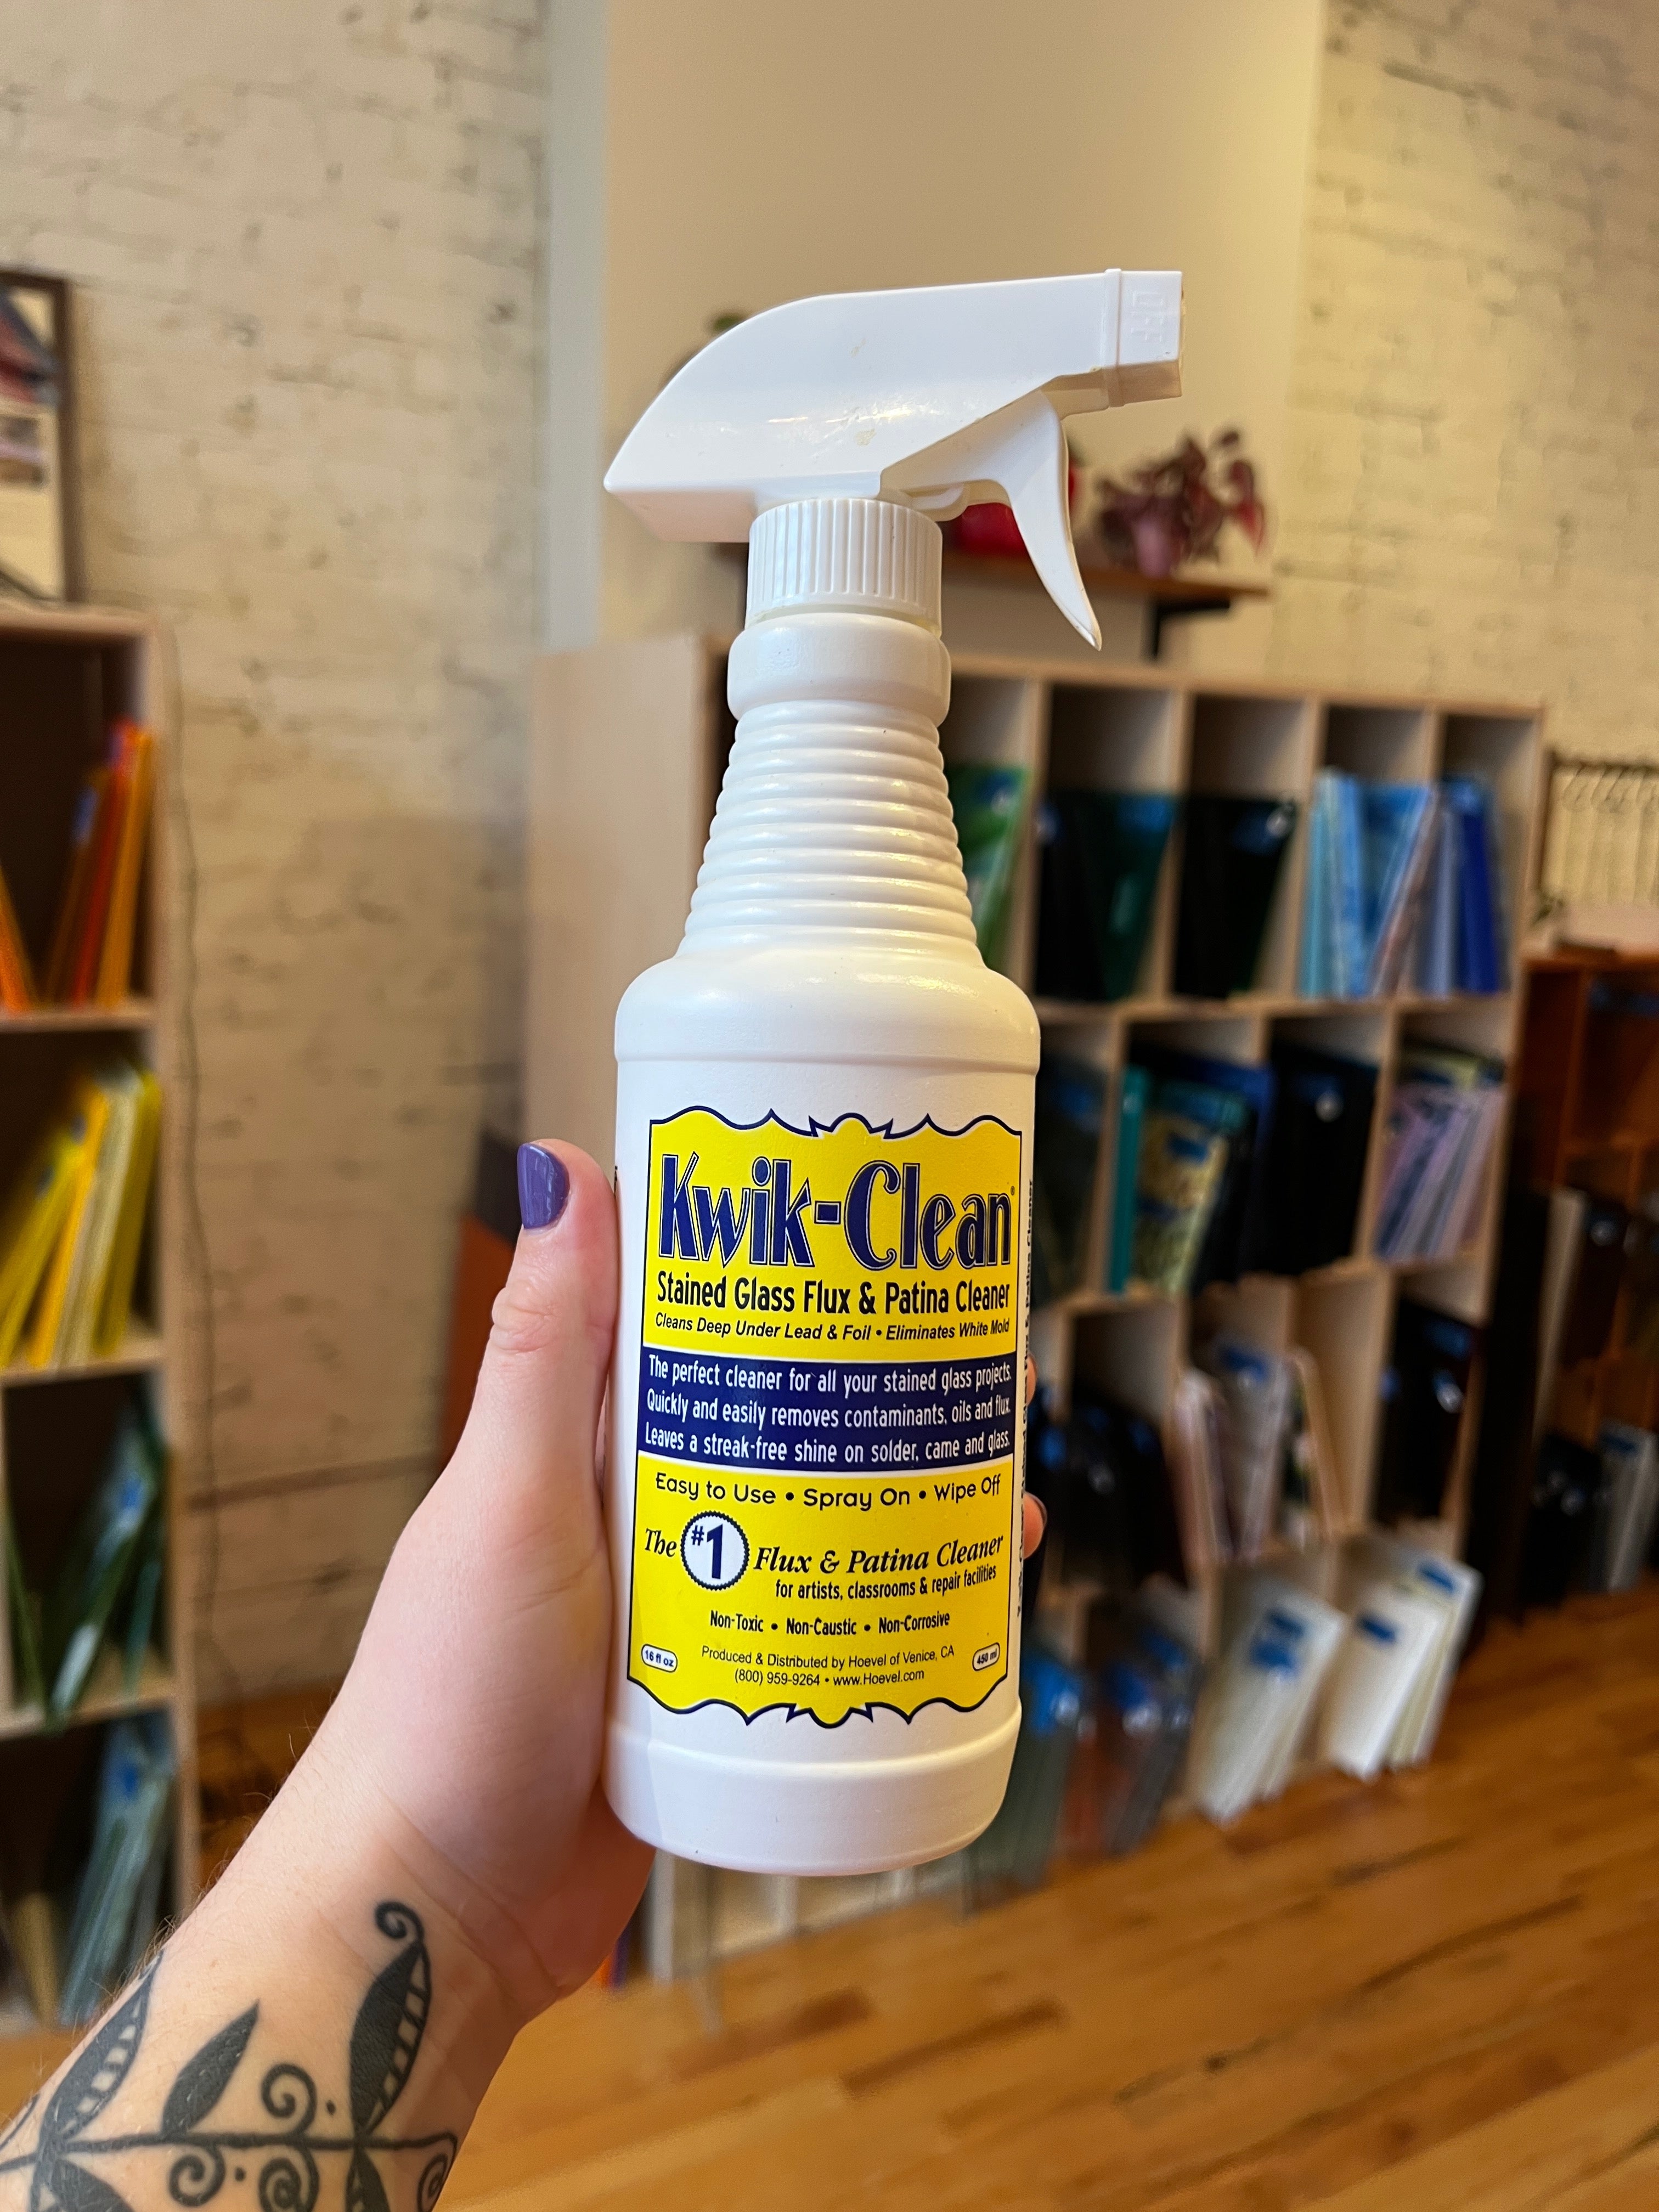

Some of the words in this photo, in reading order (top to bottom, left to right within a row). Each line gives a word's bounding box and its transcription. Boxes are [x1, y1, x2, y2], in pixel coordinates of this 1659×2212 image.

[658, 1271, 726, 1308] Stained
[735, 1276, 795, 1312] Glass
[804, 1279, 850, 1313] Flux
[859, 1281, 876, 1314] &
[885, 1280, 949, 1314] Patina
[956, 1279, 1009, 1312] Cleaner
[656, 1312, 692, 1330] Cleans
[697, 1317, 731, 1338] Deep
[736, 1321, 781, 1337] Under
[785, 1323, 823, 1339] Lead
[827, 1324, 838, 1340] &
[843, 1325, 871, 1340] Foil
[886, 1324, 955, 1340] Eliminates
[960, 1322, 988, 1337] White
[990, 1318, 1009, 1334] Mold
[649, 1354, 668, 1379] The
[672, 1360, 720, 1386] perfect
[725, 1364, 782, 1390] cleaner
[789, 1367, 811, 1391] for
[817, 1369, 836, 1392] all
[844, 1374, 877, 1399] your
[883, 1368, 936, 1392] stained
[941, 1367, 972, 1396] glass
[647, 1388, 689, 1423] Quickly
[692, 1397, 718, 1420] and
[722, 1400, 766, 1431] easily
[771, 1407, 839, 1427] removes
[951, 1400, 972, 1423] oils
[975, 1397, 993, 1420] and
[645, 1421, 684, 1450] Leaves
[689, 1435, 697, 1453] a
[703, 1432, 787, 1461] streak-free
[794, 1438, 837, 1462] shine
[844, 1444, 864, 1462] on
[926, 1438, 960, 1460] came
[965, 1431, 984, 1455] and
[656, 1471, 699, 1500] Easy
[706, 1481, 726, 1499] to
[734, 1483, 776, 1504] Use
[803, 1488, 872, 1511] Spray
[880, 1488, 910, 1505] On
[934, 1482, 977, 1504] Wipe
[981, 1474, 1001, 1496] Off
[645, 1528, 677, 1558] The
[753, 1546, 812, 1573] Flux
[820, 1550, 840, 1574] &
[845, 1548, 929, 1574] Patina
[936, 1535, 1003, 1567] Cleaner
[776, 1579, 793, 1598] for
[798, 1579, 843, 1601] artists,
[848, 1579, 915, 1599] classrooms
[919, 1576, 928, 1594] &
[932, 1571, 961, 1596] repair
[963, 1564, 996, 1587] facilities
[710, 1610, 764, 1632] Non-Toxic
[786, 1617, 856, 1635] Non-Caustic
[878, 1611, 950, 1634] Non-Corrosive
[645, 1650, 654, 1661] 16
[656, 1653, 661, 1663] fl
[663, 1658, 674, 1667] oz
[702, 1645, 752, 1664] Produced
[755, 1652, 763, 1665] &
[768, 1654, 828, 1668] Distributed
[832, 1656, 845, 1671] by
[849, 1654, 887, 1668] Hoevel
[890, 1652, 900, 1665] of
[902, 1650, 937, 1663] Venice,
[940, 1645, 955, 1658] CA
[990, 1648, 997, 1660] ml
[735, 1668, 763, 1686] (800)
[767, 1673, 820, 1686] 959-9264
[833, 1669, 924, 1686] www.Hoevel.com
